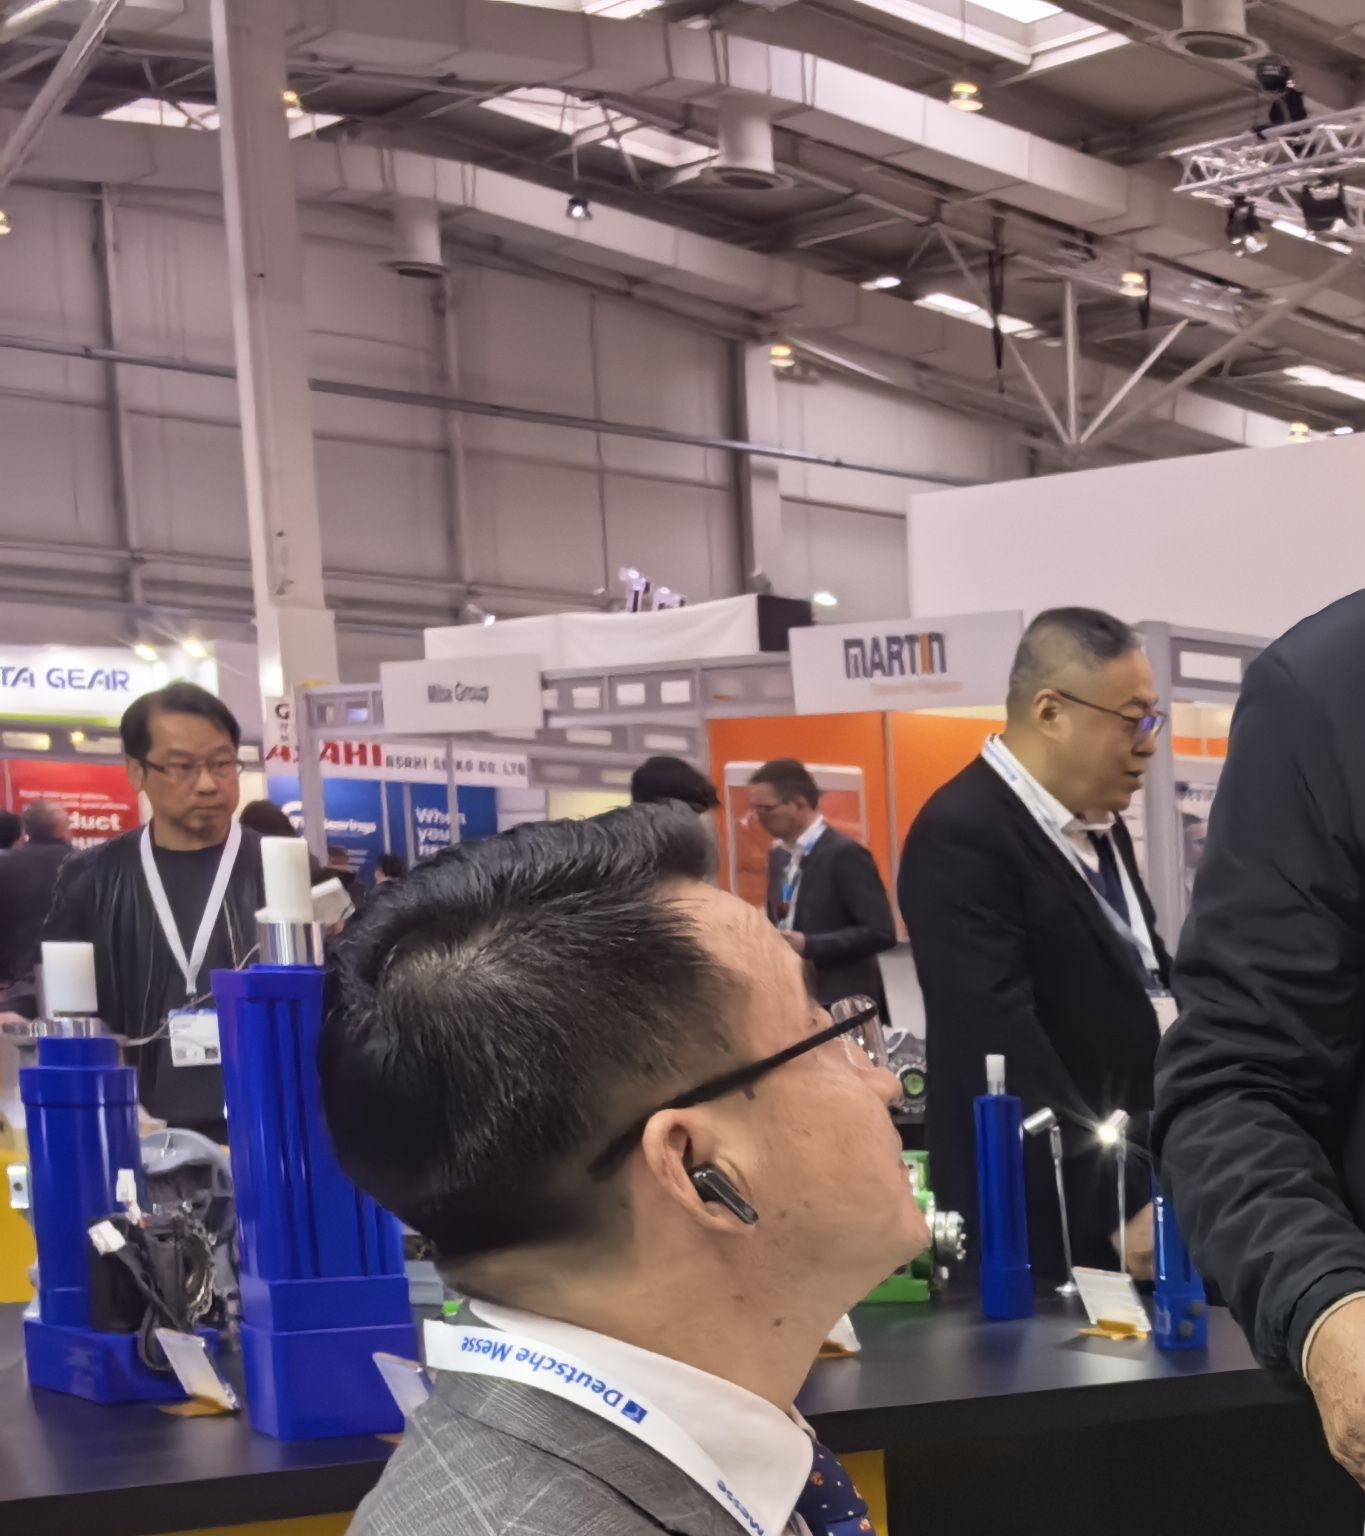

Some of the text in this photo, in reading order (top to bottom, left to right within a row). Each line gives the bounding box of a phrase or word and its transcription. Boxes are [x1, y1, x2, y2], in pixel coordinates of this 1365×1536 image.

[46, 667, 131, 691] GEAR
[843, 631, 948, 679] MARTIN
[461, 1335, 624, 1408] Deutsche Messe
